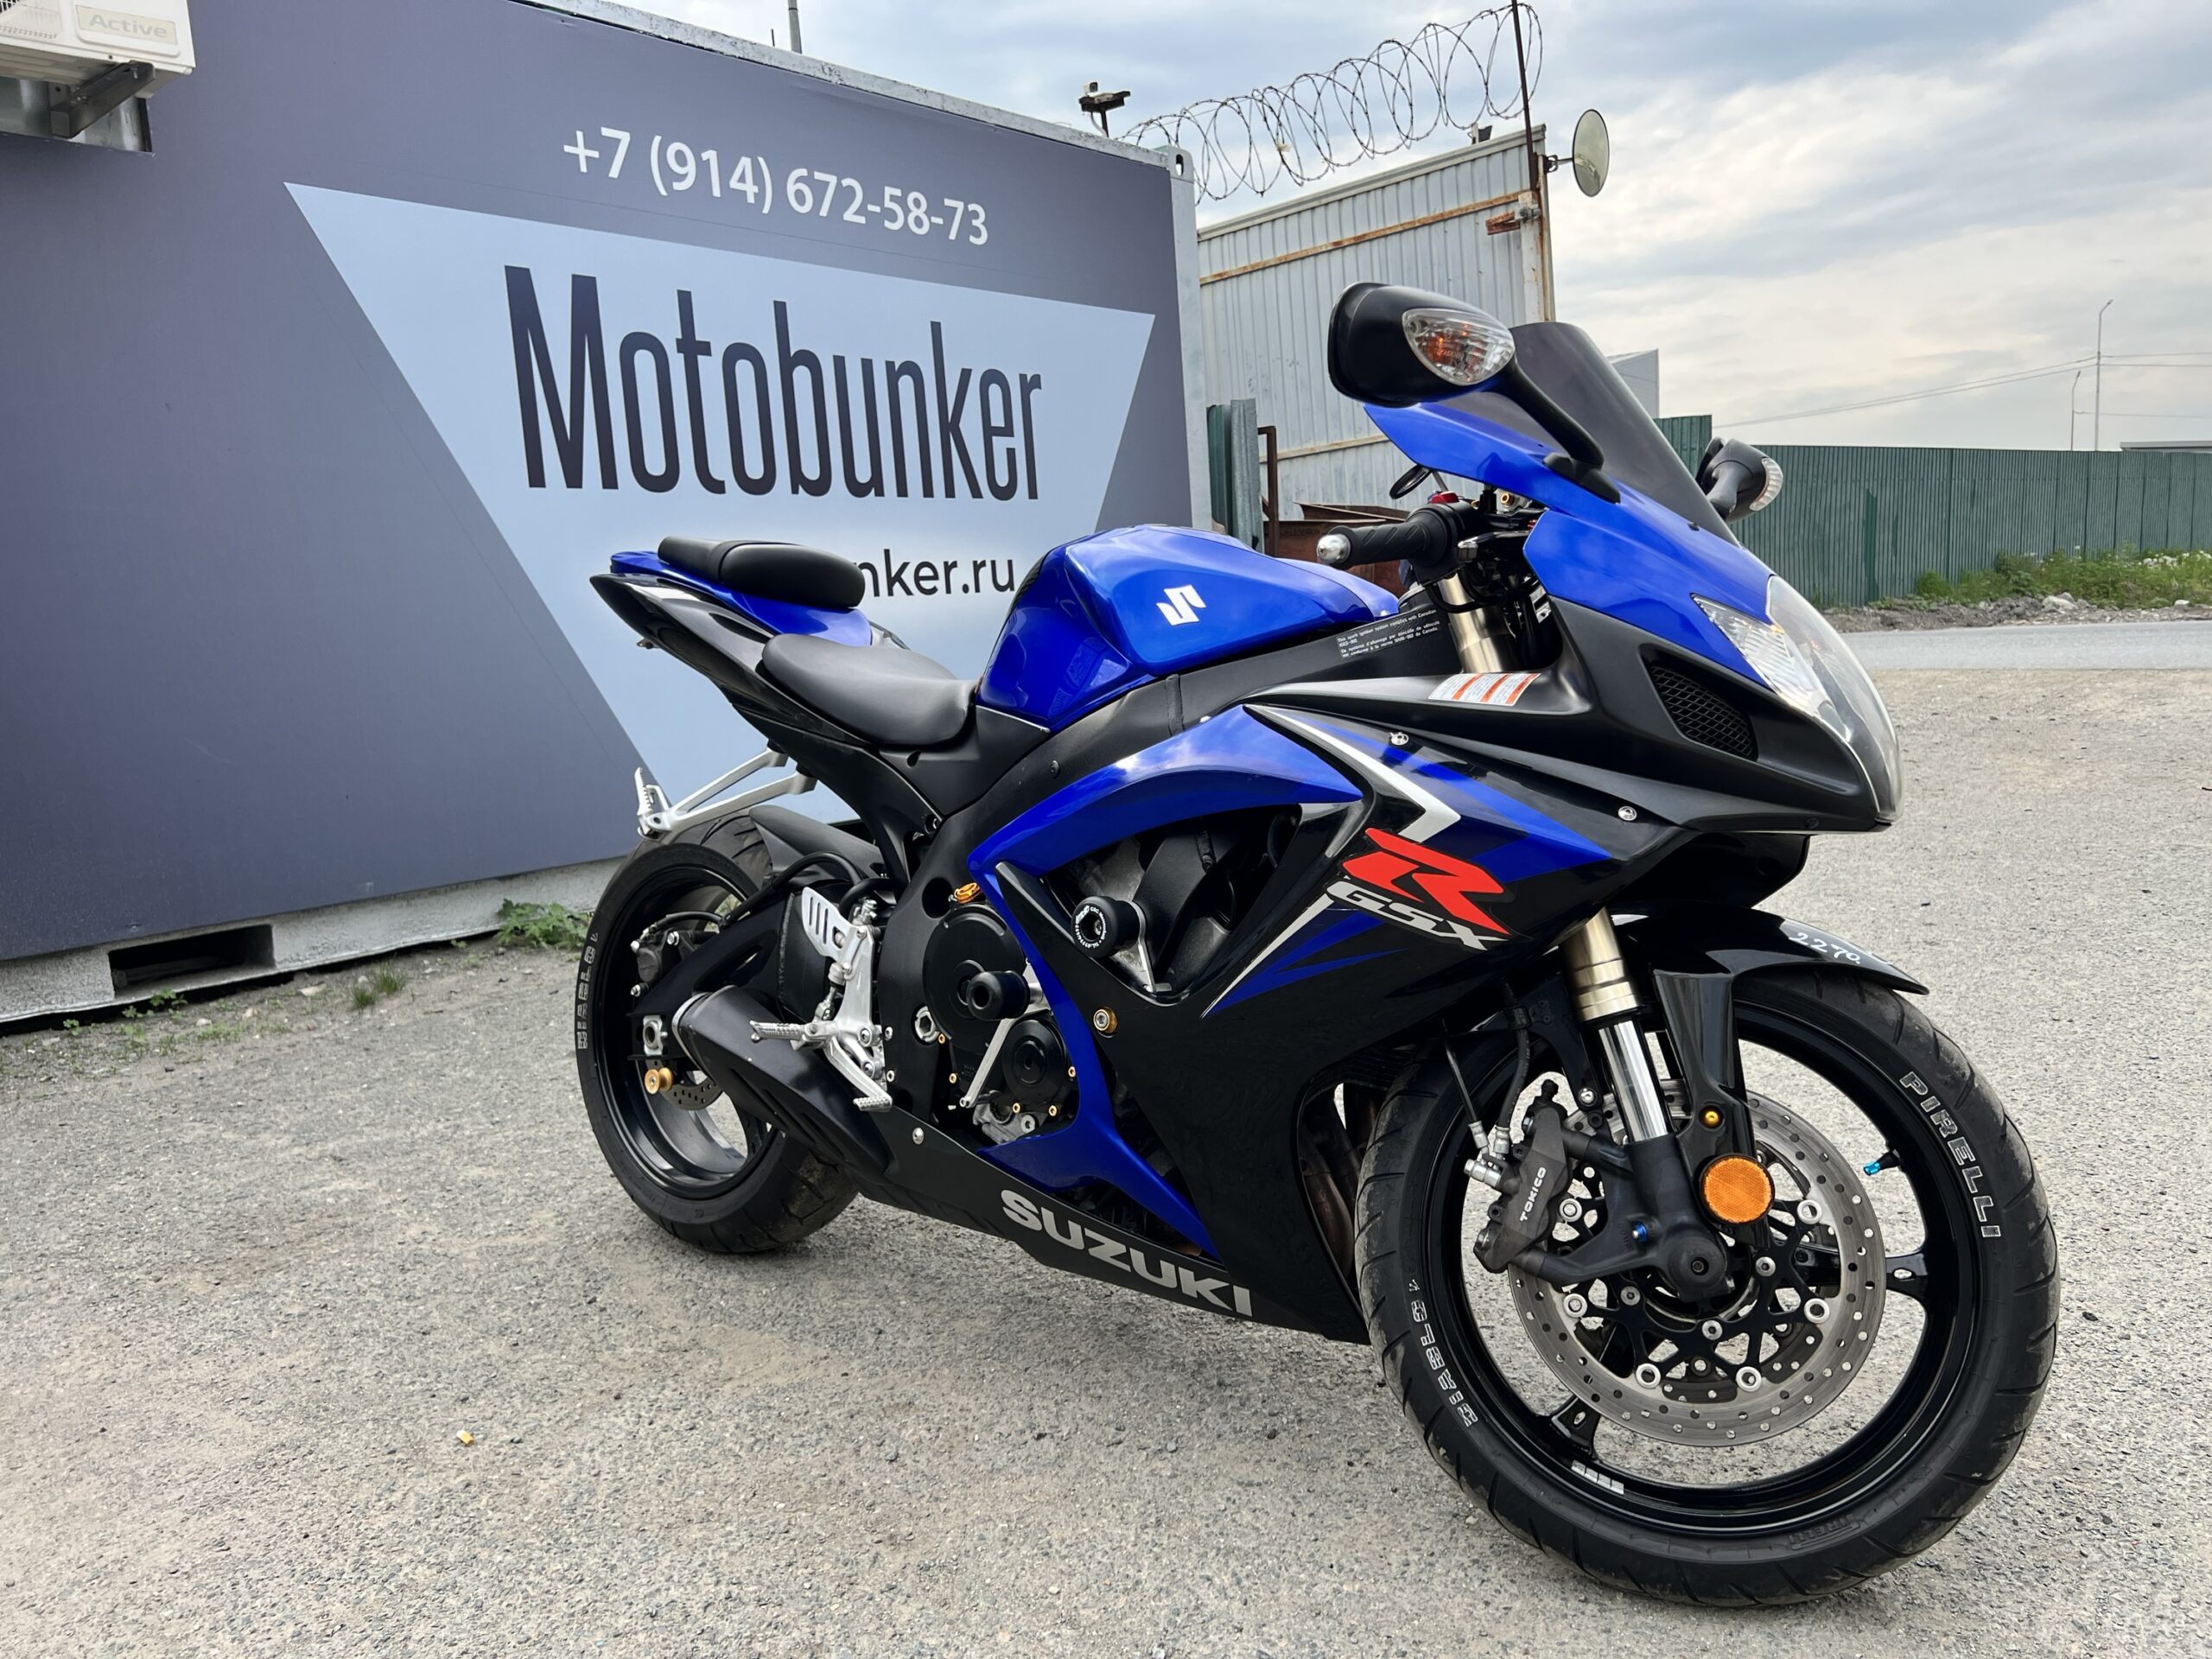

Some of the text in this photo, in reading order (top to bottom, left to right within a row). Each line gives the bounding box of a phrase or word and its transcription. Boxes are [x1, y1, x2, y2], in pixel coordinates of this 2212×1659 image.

[90, 13, 168, 39] Active
[563, 127, 989, 245] +7 (914) 672-58-73
[504, 264, 1043, 501] Motobunker
[1418, 609, 1437, 618] Canadian
[1326, 880, 1509, 951] GSX
[1342, 827, 1510, 935] R
[1519, 1166, 1547, 1222] TOKICO
[1899, 1071, 2002, 1237] PIRELLI
[1000, 1189, 1254, 1318] SUZUKI
